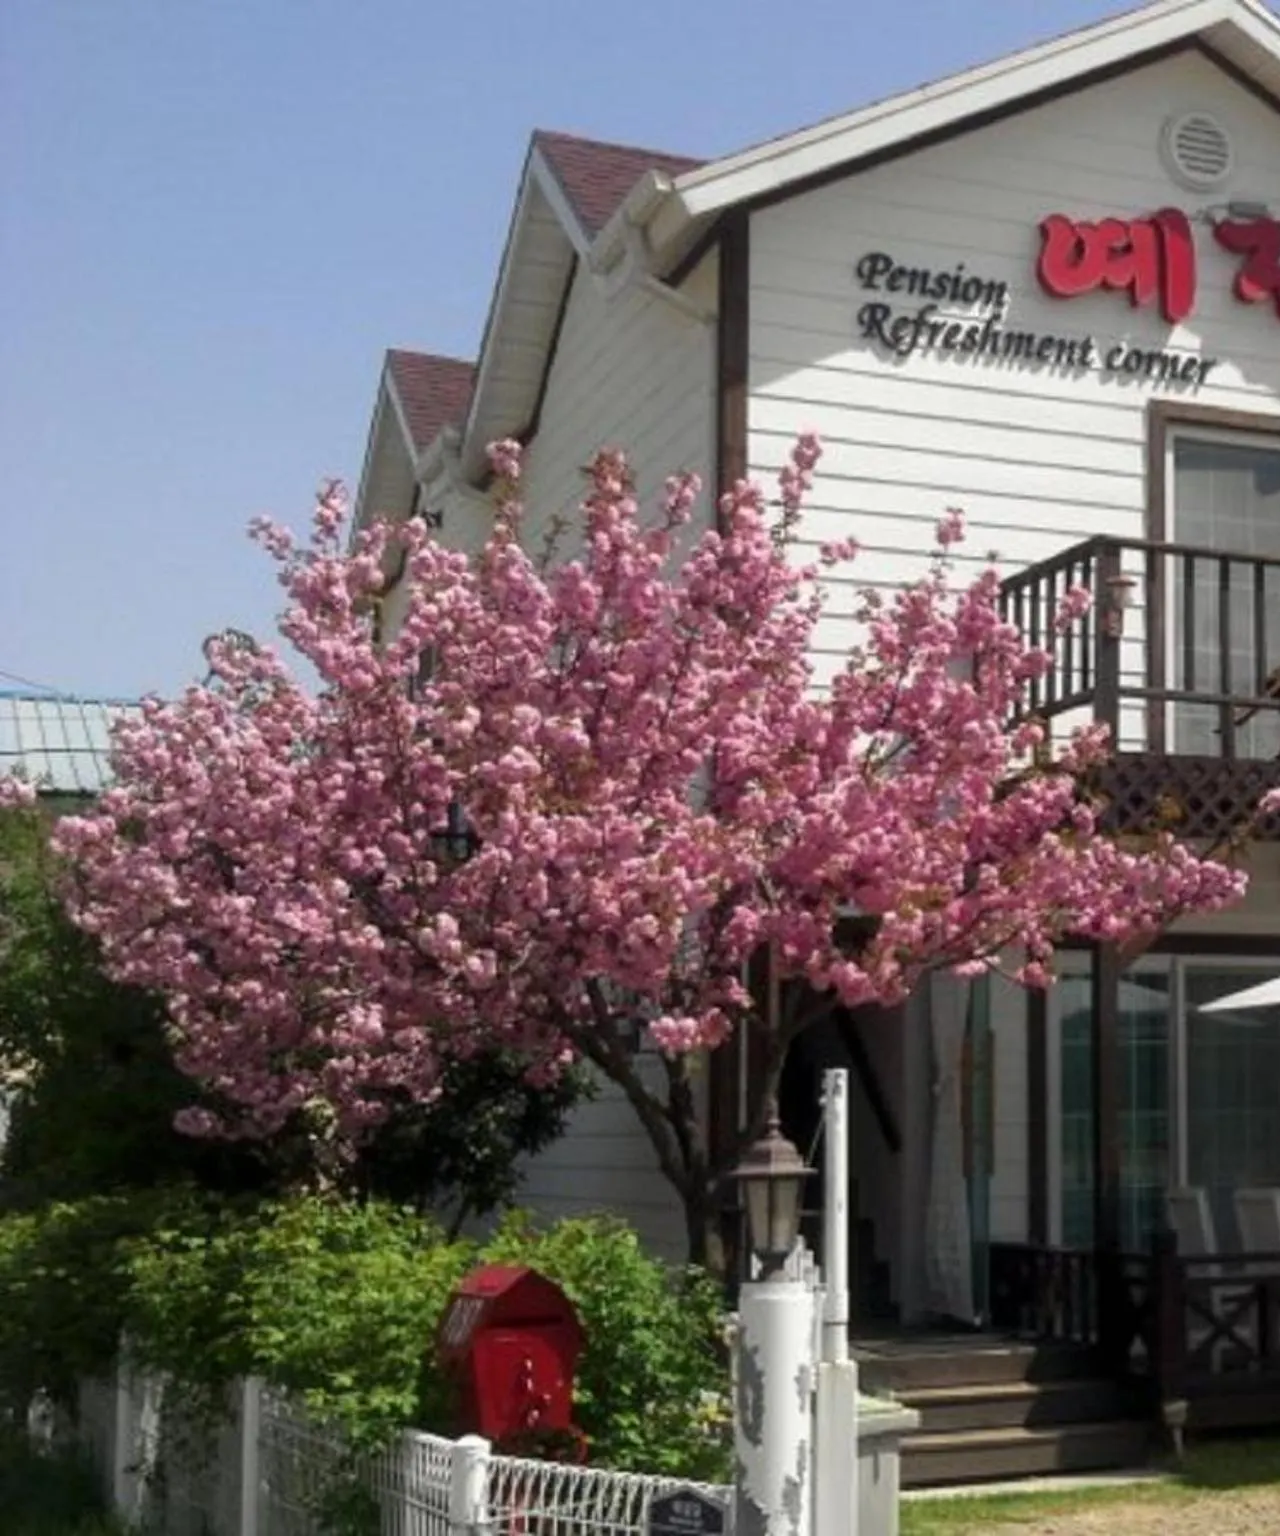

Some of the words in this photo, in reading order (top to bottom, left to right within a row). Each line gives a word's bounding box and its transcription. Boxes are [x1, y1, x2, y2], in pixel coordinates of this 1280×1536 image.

[856, 251, 1007, 306] Pension
[856, 302, 1095, 367] Refreshment
[1105, 345, 1217, 387] corner
